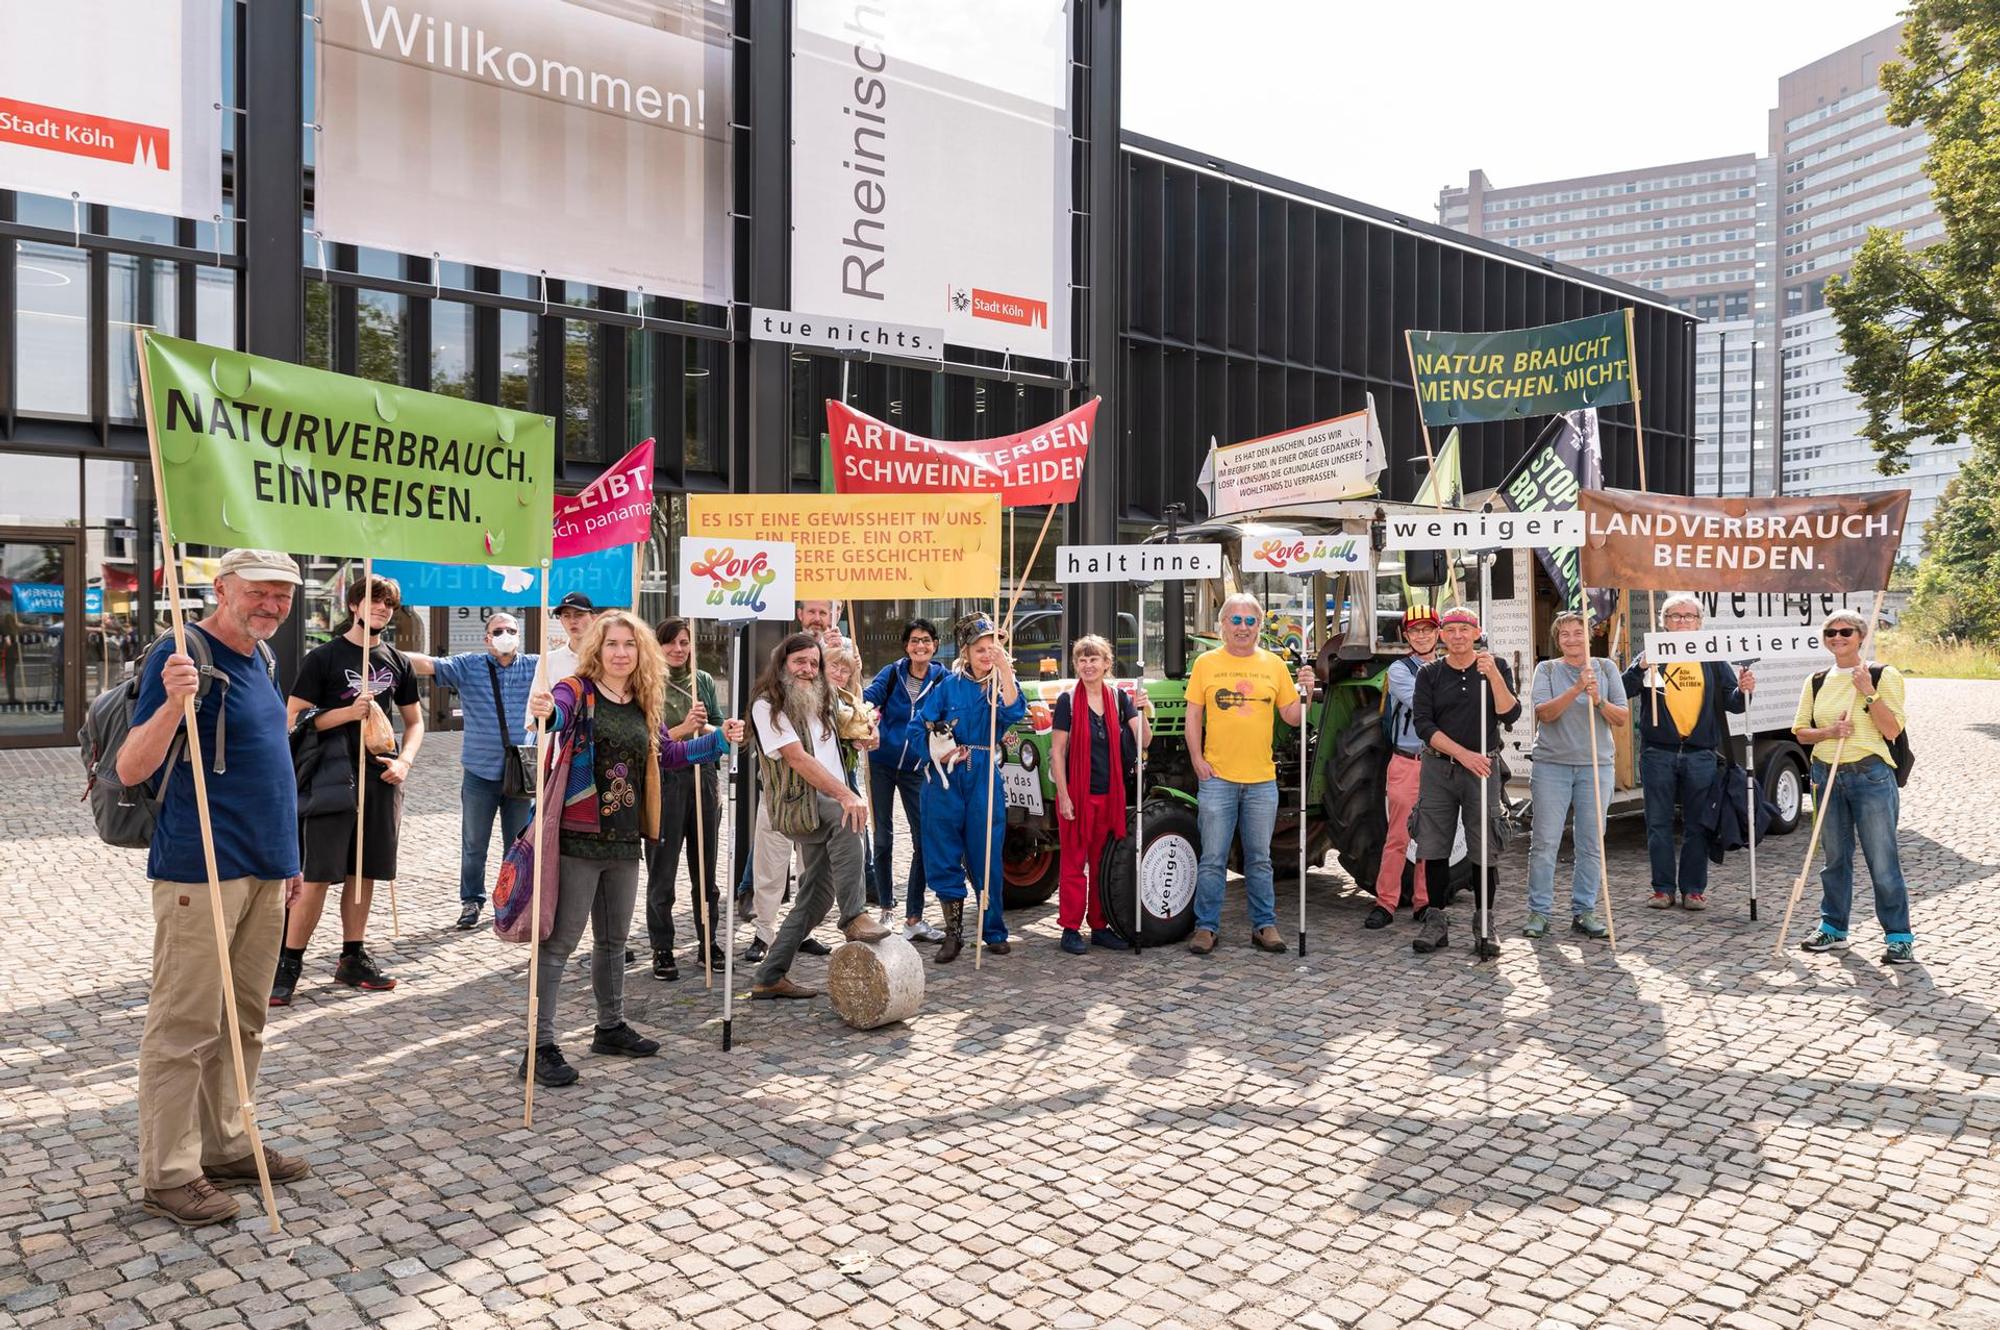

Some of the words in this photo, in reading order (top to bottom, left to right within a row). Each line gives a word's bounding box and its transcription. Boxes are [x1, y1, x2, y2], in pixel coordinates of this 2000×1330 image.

[360, 0, 705, 130] Willkommen!
[0, 112, 60, 139] Stadt
[65, 124, 115, 149] Köln
[843, 0, 887, 301] Rheinisch
[974, 298, 1001, 314] Stadt
[1002, 302, 1024, 319] Köln
[763, 316, 812, 337] tue
[827, 324, 933, 350] nichts.
[1417, 354, 1504, 375] NATUR
[1513, 336, 1611, 373] BRAUCHT
[1420, 375, 1559, 403] MENSCHEN.
[1564, 360, 1631, 391] NICHT.
[166, 388, 533, 484] NATURVERBRAUCH.
[1234, 455, 1242, 463] ES
[1243, 451, 1256, 461] HAT
[1257, 449, 1270, 459] DEN
[1308, 434, 1327, 446] DASS
[1328, 429, 1342, 440] WIR
[845, 455, 996, 488] SCHWEINE.
[1218, 469, 1226, 477] IM
[1227, 464, 1251, 476] BEGRIFF
[1270, 457, 1277, 467] IN
[1278, 453, 1297, 465] EINER
[1298, 447, 1319, 461] ORGIE
[1240, 471, 1271, 486] KONSUMS
[1271, 468, 1282, 479] DIE
[1283, 456, 1330, 477] GRUNDLAGEN
[1331, 450, 1363, 466] UNSERES
[1530, 446, 1580, 507] STOP
[253, 459, 481, 524] EINPREISEN.
[1239, 480, 1284, 498] WOHLSTANDS
[1284, 478, 1293, 488] ZU
[701, 512, 721, 527] ES
[728, 512, 755, 527] IST
[761, 512, 801, 527] EINE
[807, 512, 915, 527] GEWISSHEIT
[922, 512, 940, 526] IN
[946, 511, 988, 526] UNS.
[1394, 516, 1579, 541] weniger.
[1590, 512, 1900, 540] LANDVERBRAUCH.
[791, 531, 856, 545] FRIEDE.
[863, 531, 892, 545] EIN
[898, 530, 937, 545] ORT.
[795, 549, 835, 563] SERE
[842, 548, 964, 563] GESCHICHTEN
[1068, 552, 1128, 573] halt
[1141, 552, 1212, 571] inne.
[1253, 539, 1310, 568] Love
[1312, 540, 1328, 559] is
[1329, 539, 1359, 563] all
[1653, 544, 1825, 570] BEENDEN.
[690, 546, 777, 592] Love
[794, 567, 913, 583] ERSTUMMEN.
[705, 582, 725, 606] is
[730, 582, 767, 613] all
[1155, 700, 1188, 709] EUTZ
[1014, 773, 1032, 787] das
[1005, 788, 1040, 807] eben.
[1160, 837, 1178, 916] weniger.
